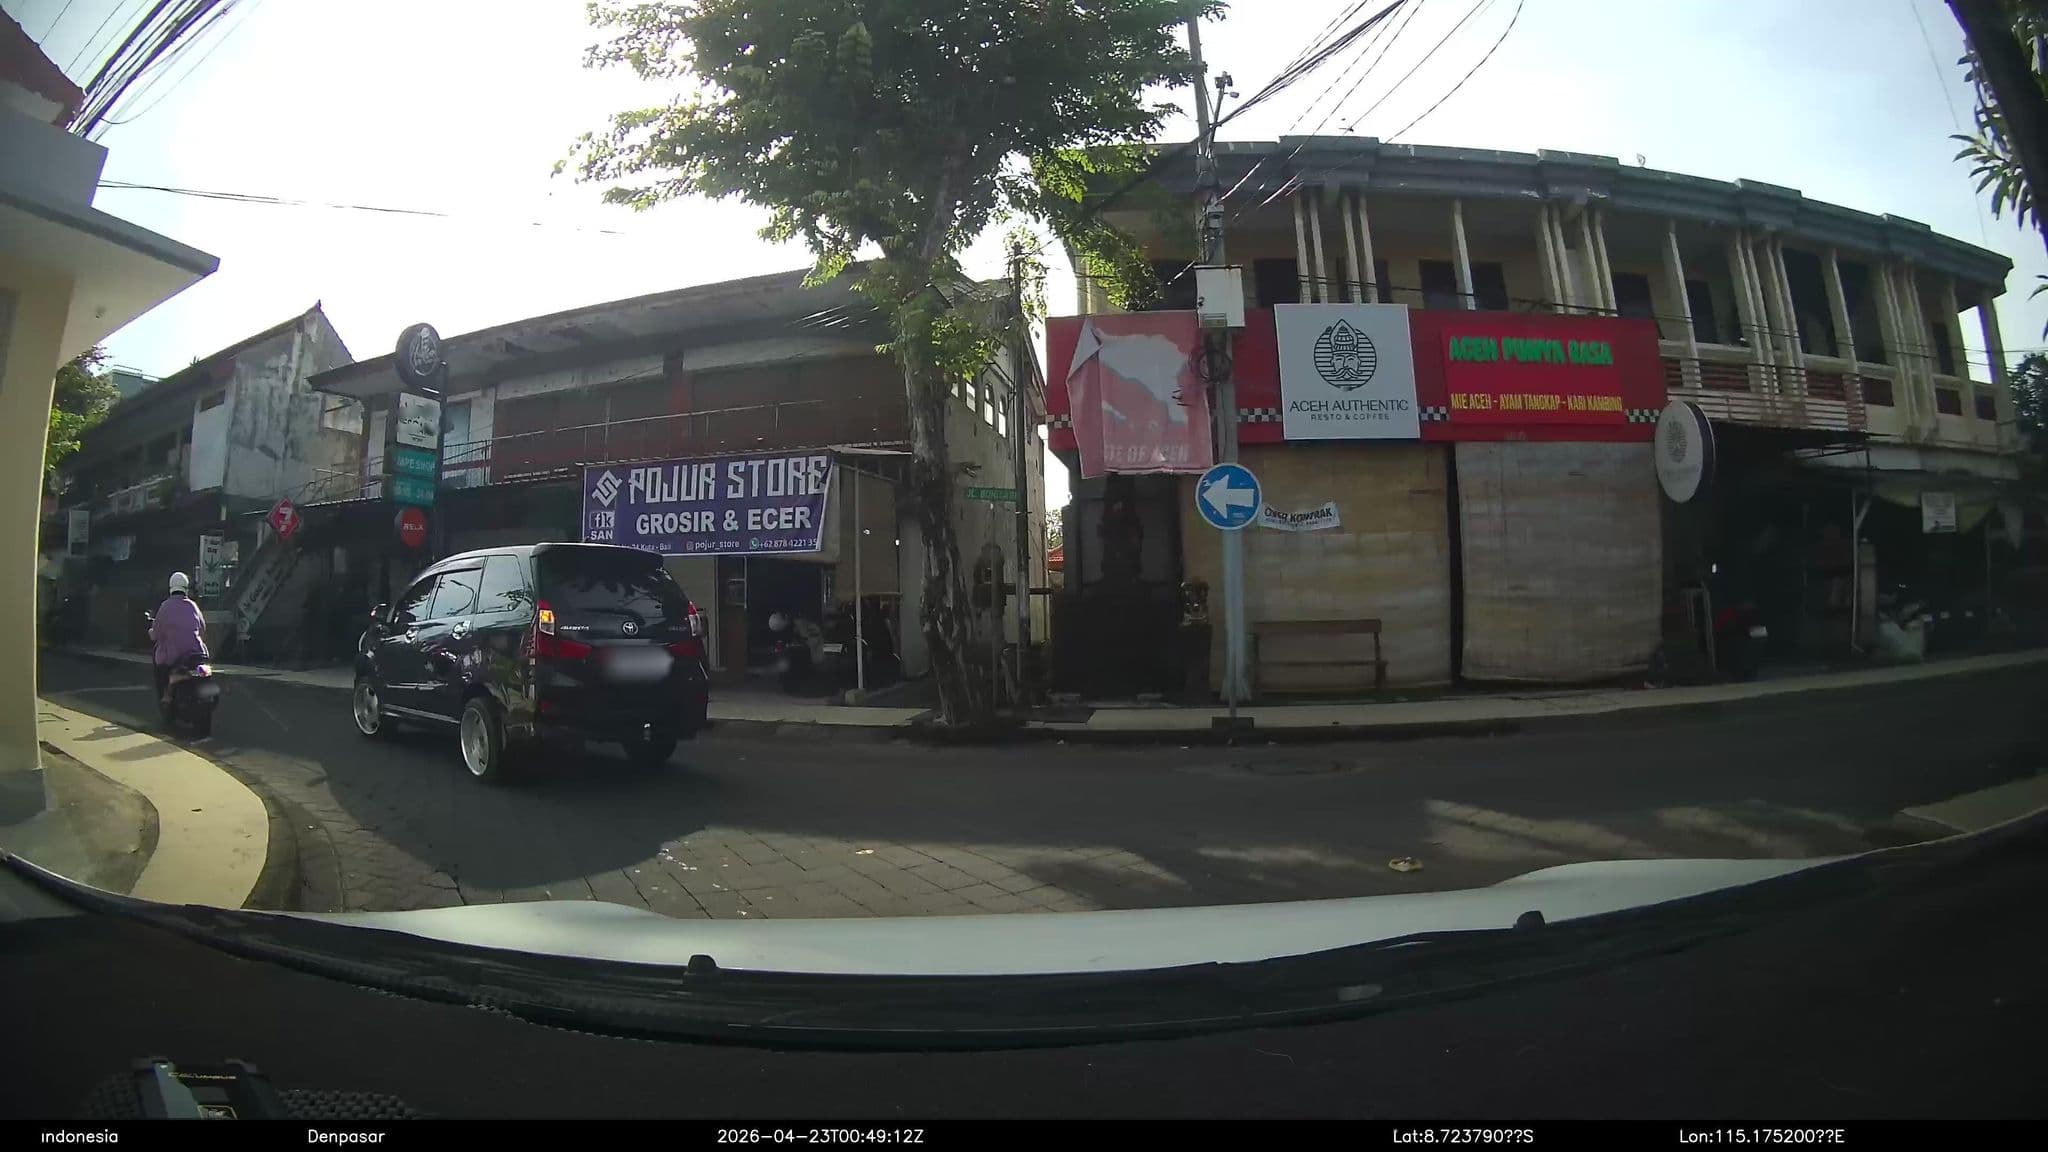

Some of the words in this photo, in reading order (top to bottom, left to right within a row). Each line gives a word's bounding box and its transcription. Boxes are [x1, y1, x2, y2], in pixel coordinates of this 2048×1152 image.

[1449, 336, 1498, 362] ACEH
[1290, 400, 1329, 412] ACEH
[1332, 400, 1409, 411] AUTHENTIC
[1450, 392, 1468, 410] MIE
[1469, 393, 1492, 410] ACEH
[1500, 393, 1522, 411] AYAM
[1523, 394, 1560, 411] TANGKAP
[1567, 394, 1586, 411] KARI
[1311, 413, 1341, 421] RESTO
[628, 463, 716, 504] POJUR
[727, 456, 828, 499] STORE
[636, 511, 716, 535] GROSIR
[723, 510, 739, 532] &
[747, 507, 812, 530] ECER
[695, 540, 740, 551] pojur_store
